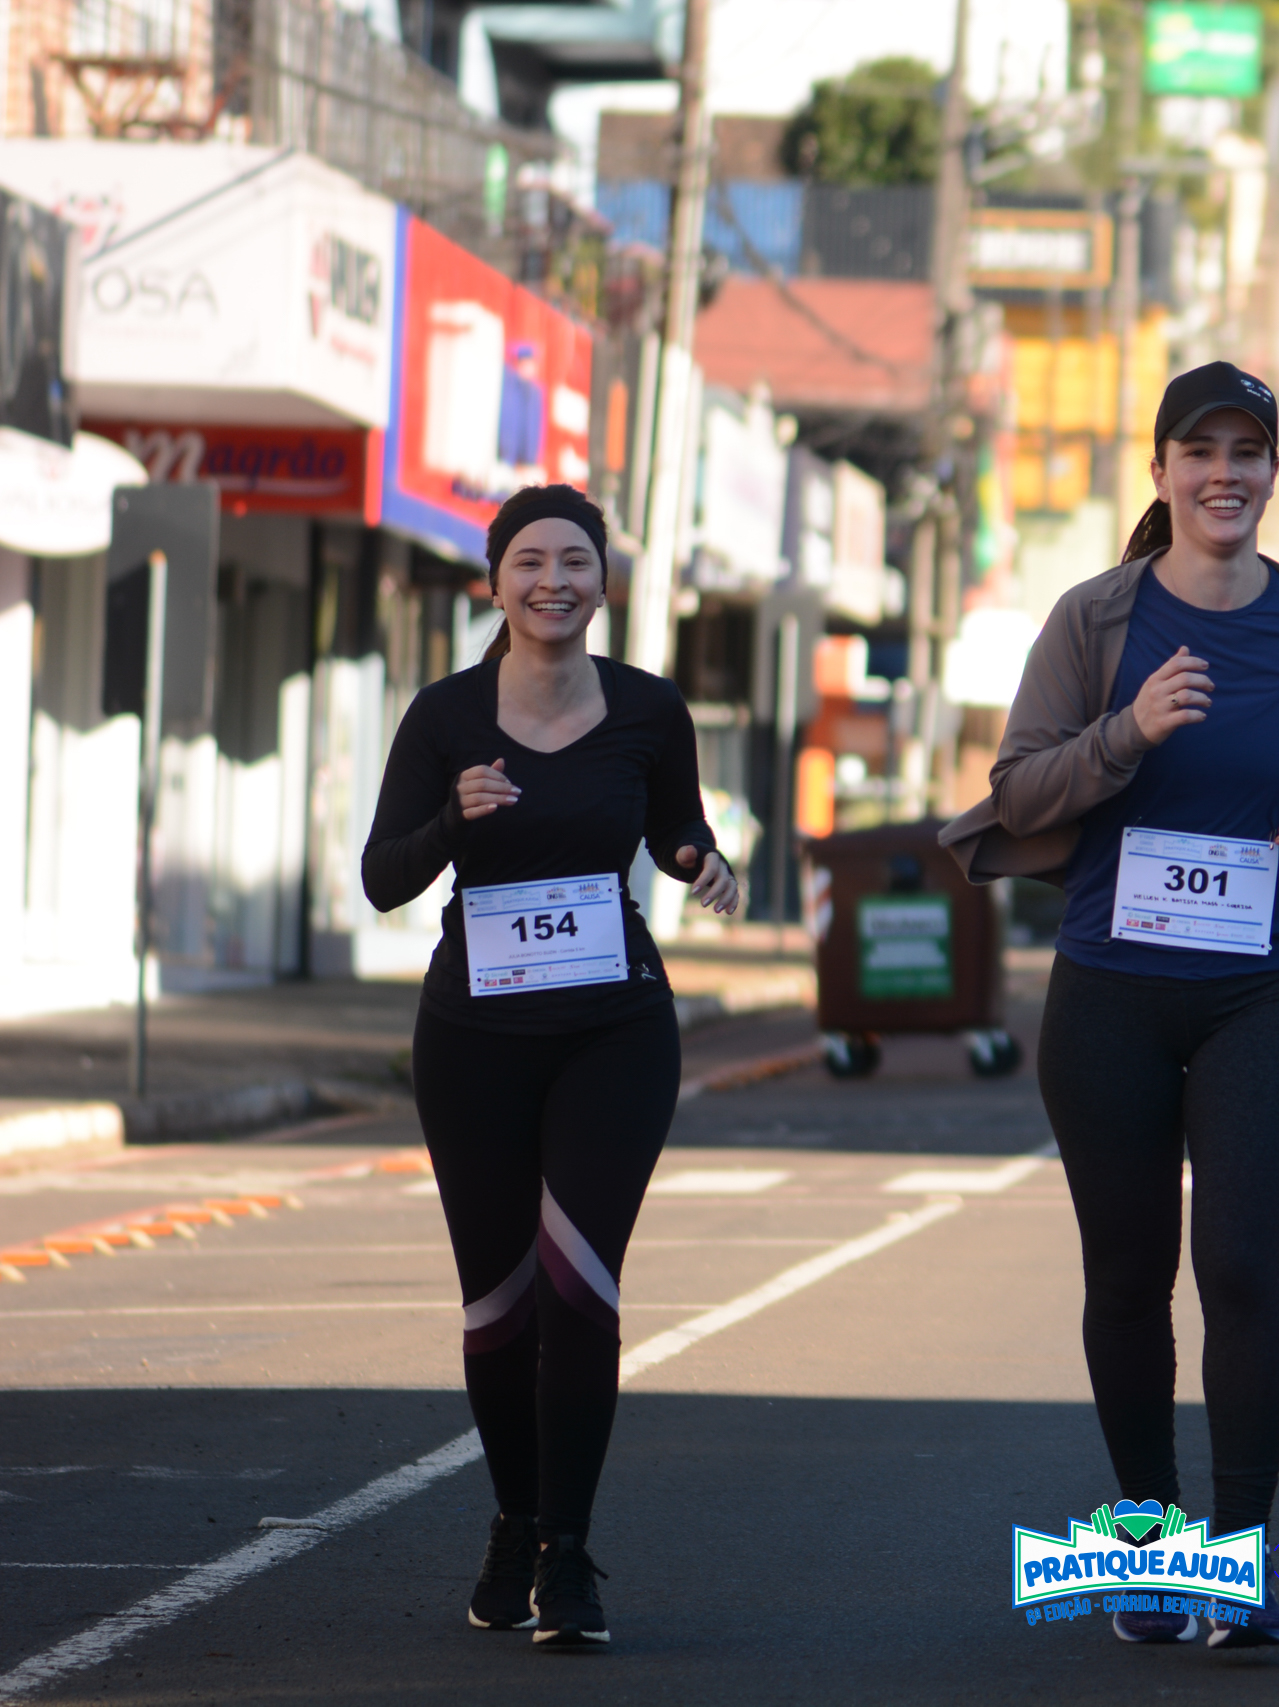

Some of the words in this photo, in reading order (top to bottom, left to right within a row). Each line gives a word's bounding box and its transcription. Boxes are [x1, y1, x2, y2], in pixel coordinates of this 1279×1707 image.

[1163, 864, 1228, 897] 301
[1171, 897, 1198, 905] BATISTA
[511, 910, 579, 943] 154
